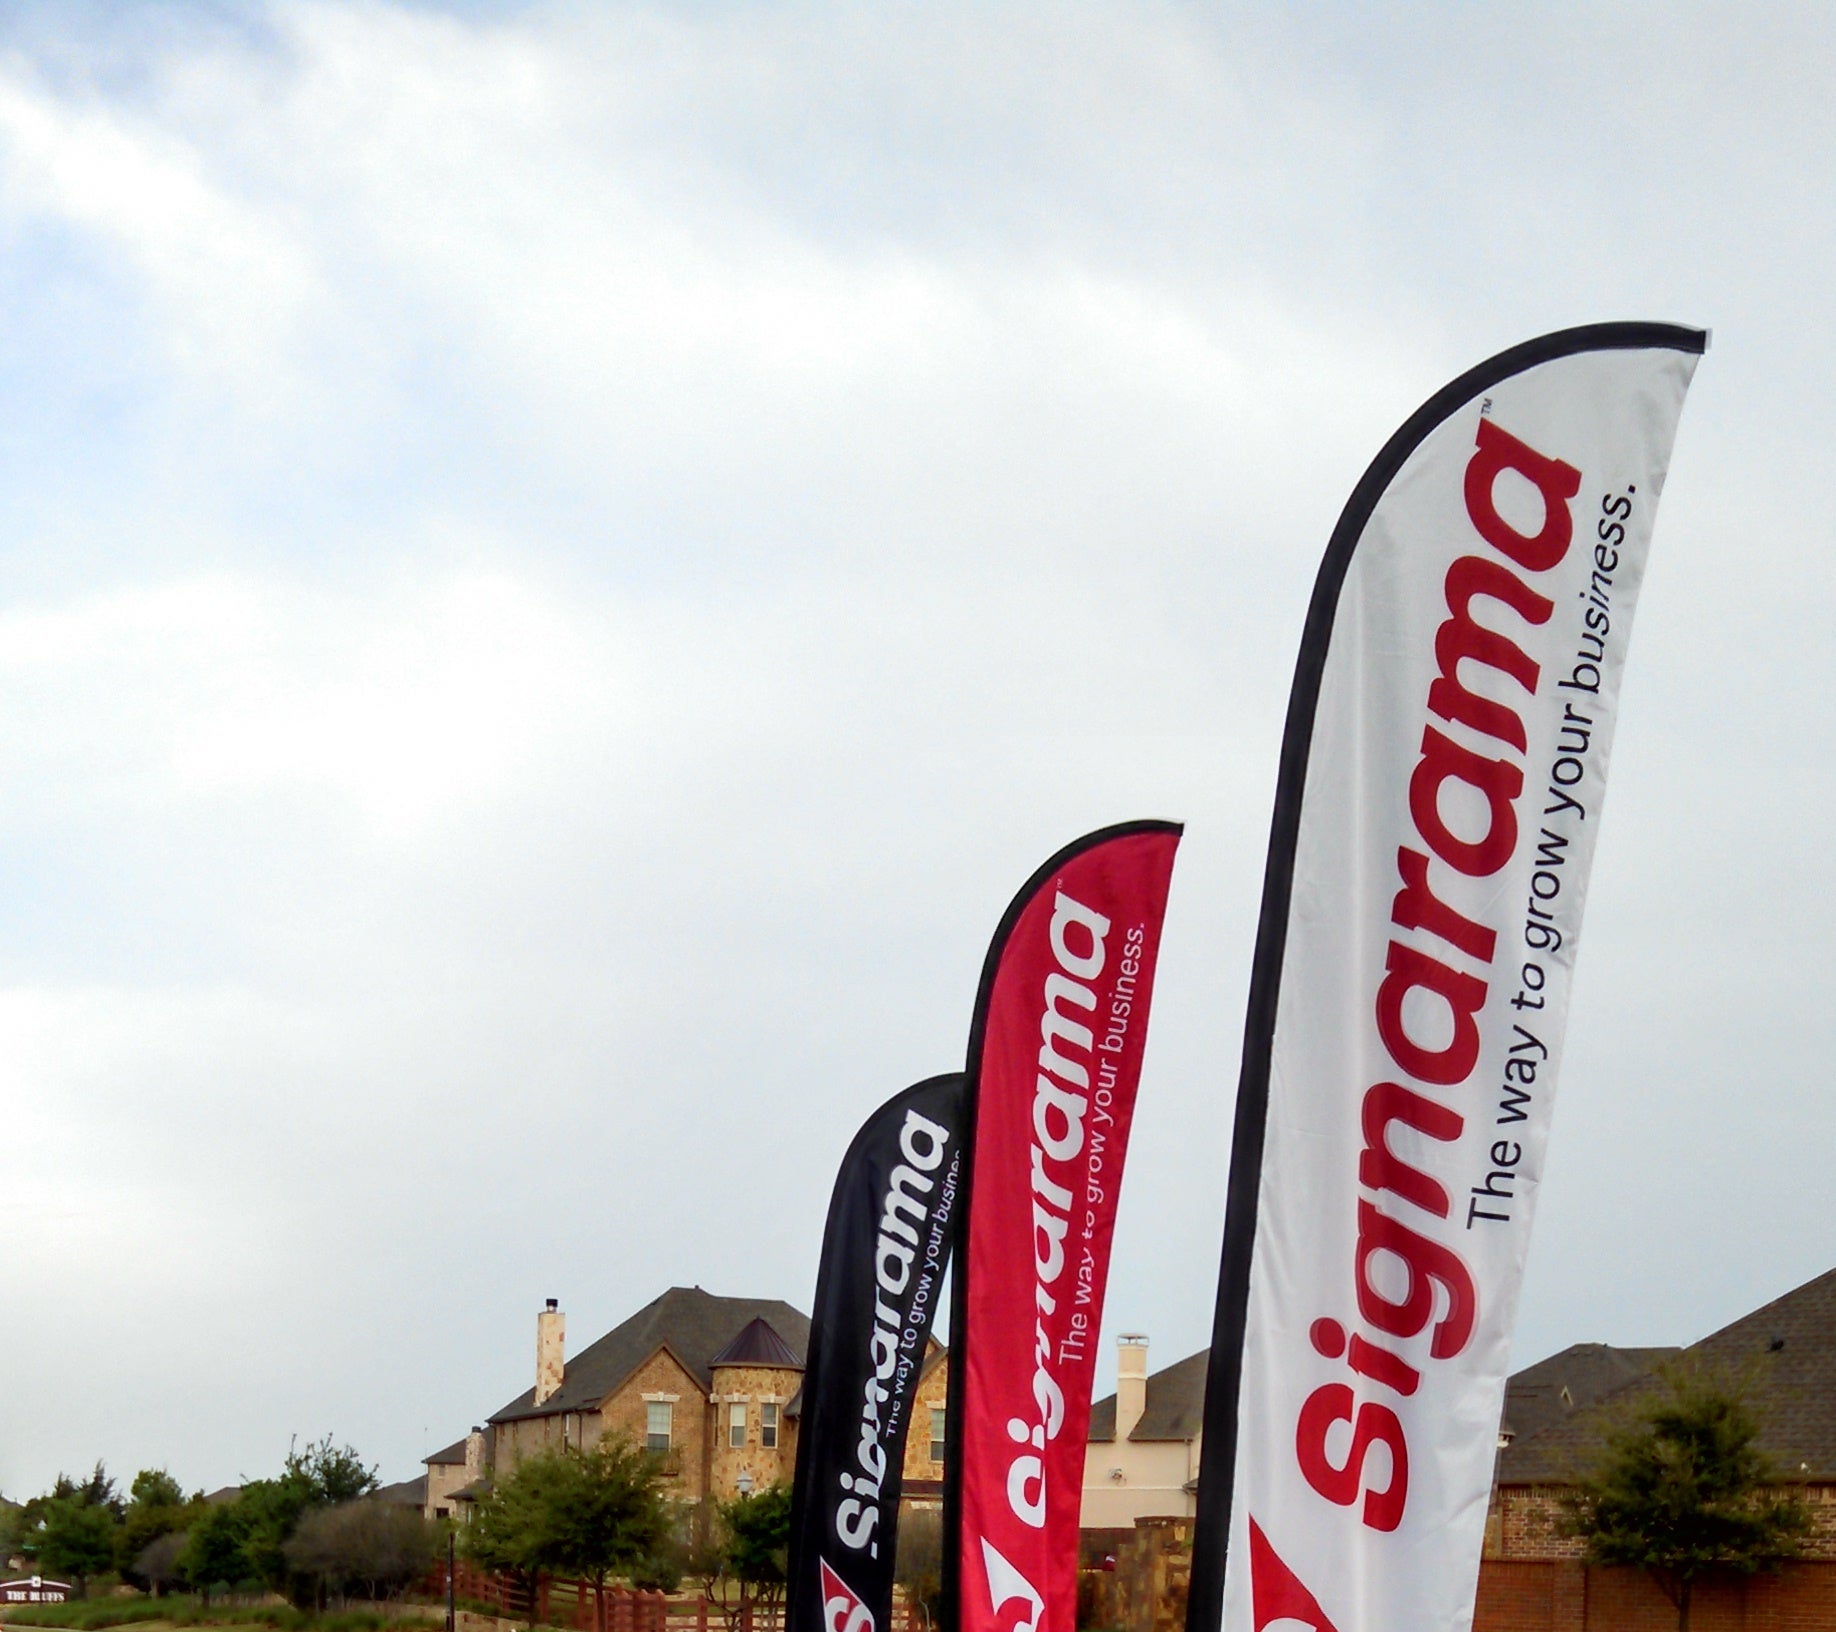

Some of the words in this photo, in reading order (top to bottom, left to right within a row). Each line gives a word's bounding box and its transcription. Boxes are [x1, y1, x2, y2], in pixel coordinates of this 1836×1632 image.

[1558, 485, 1636, 694] business.
[1543, 703, 1593, 820] your
[1525, 828, 1569, 953] grow
[1098, 923, 1145, 1053] business.
[1296, 417, 1582, 1532] Signarama
[1510, 962, 1546, 1011] to
[1092, 1057, 1119, 1127] your
[1497, 1024, 1548, 1125] way
[931, 1149, 960, 1223] busine
[1086, 1131, 1106, 1204] grow
[1466, 1140, 1522, 1230] The
[923, 1223, 945, 1271] your
[1081, 1210, 1096, 1239] to
[908, 1273, 934, 1324] grow
[1075, 1249, 1096, 1306] way
[900, 1328, 918, 1350] to
[1058, 1312, 1088, 1366] The
[894, 1353, 915, 1395] way
[885, 1400, 901, 1438] The
[6, 1590, 28, 1600] THE
